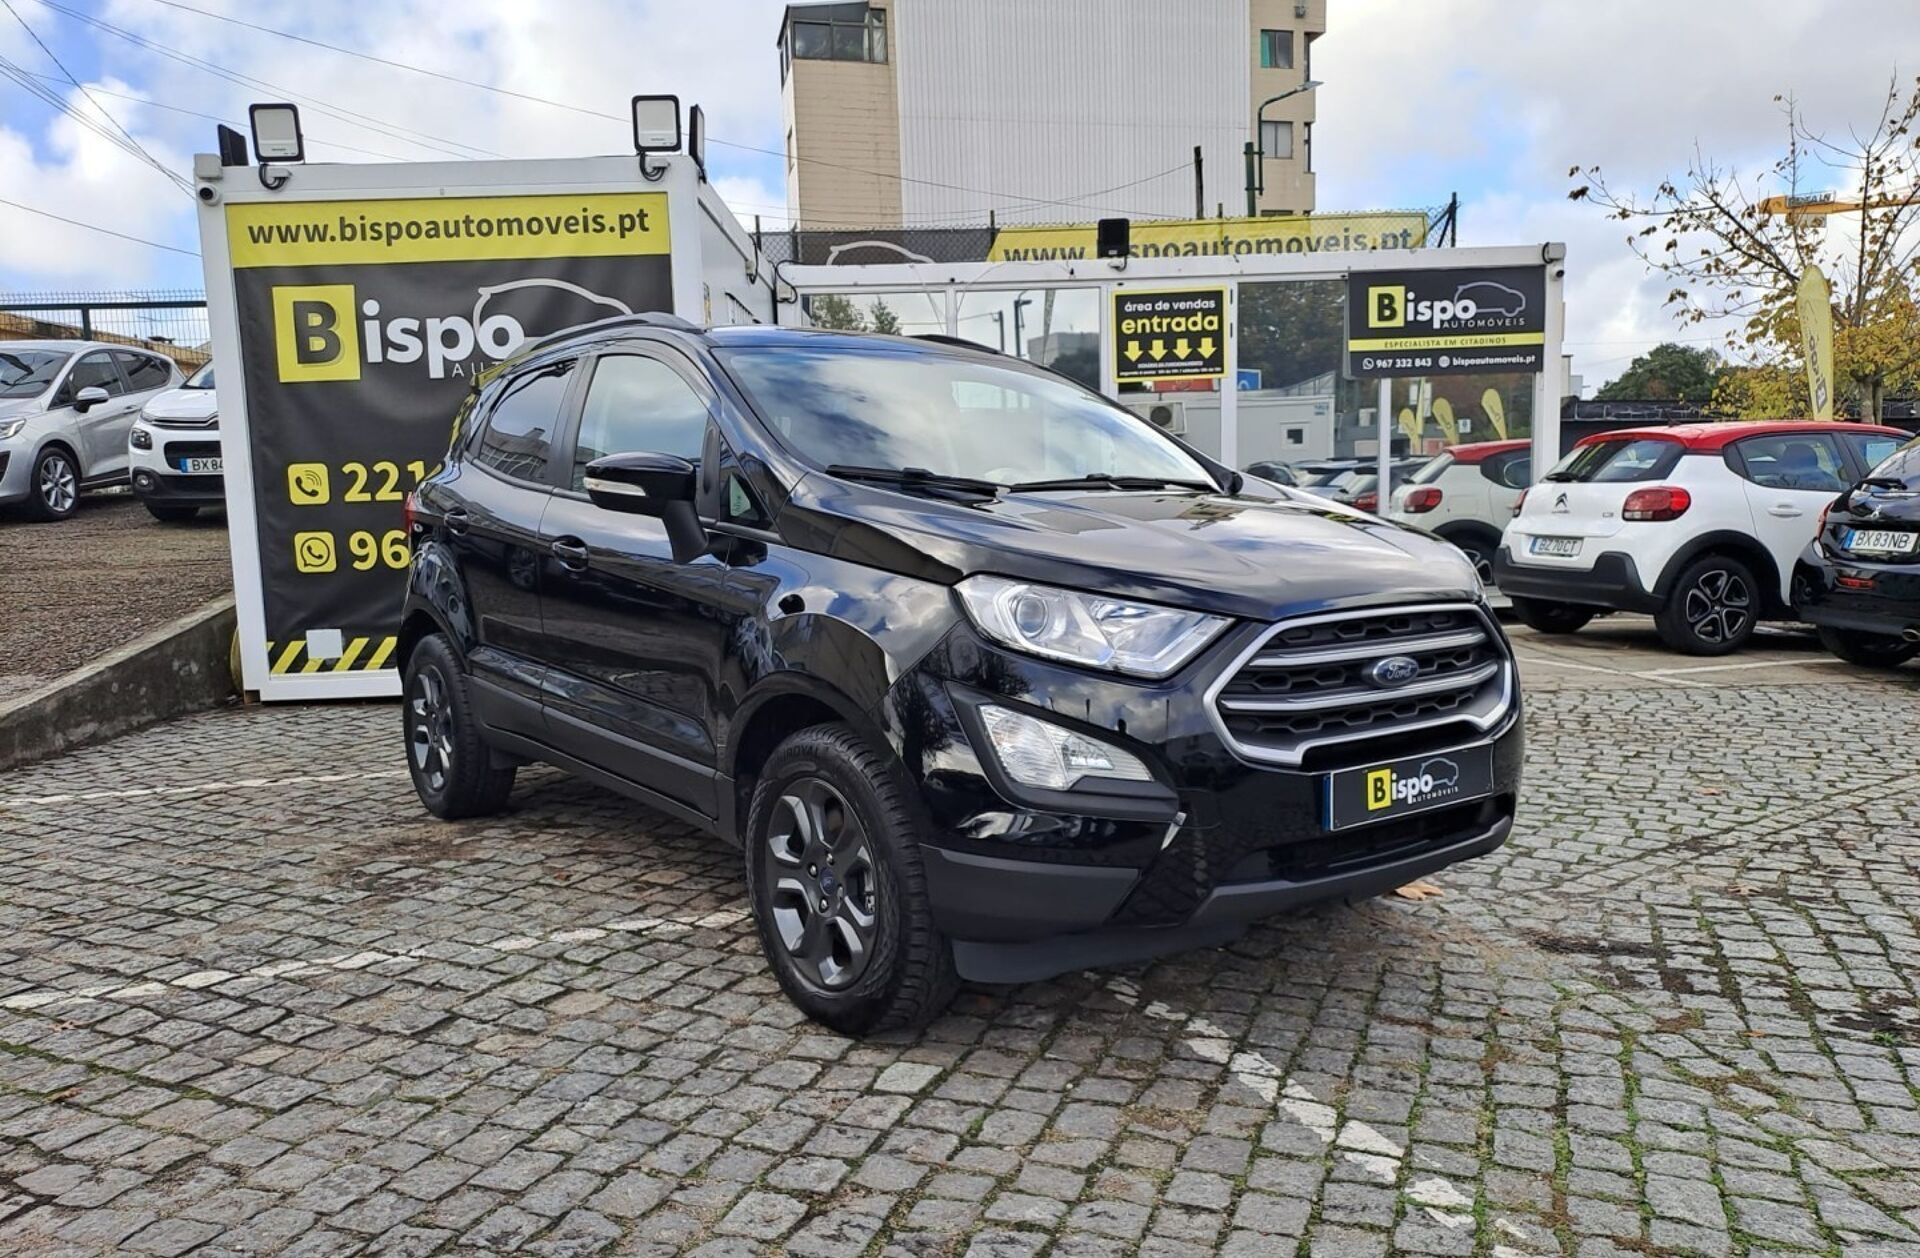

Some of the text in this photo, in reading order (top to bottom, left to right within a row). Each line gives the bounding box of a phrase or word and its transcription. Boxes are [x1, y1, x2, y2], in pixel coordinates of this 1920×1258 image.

[248, 208, 649, 246] www.bispoautomoveis.pt
[1155, 300, 1170, 311] de
[1172, 299, 1215, 310] vendas
[1377, 291, 1477, 329] Bispo
[1121, 311, 1218, 334] entrada
[1443, 317, 1526, 328] AUTOMÓVEIS
[292, 298, 525, 379] Bispo
[1384, 337, 1507, 349] ESPECIALISTA EM CITADINOS
[1376, 357, 1432, 368] 967 332 843
[349, 529, 410, 571] 96
[1856, 531, 1910, 549] BX83NB
[1387, 661, 1412, 680] Ford
[1374, 772, 1434, 804] Bispo
